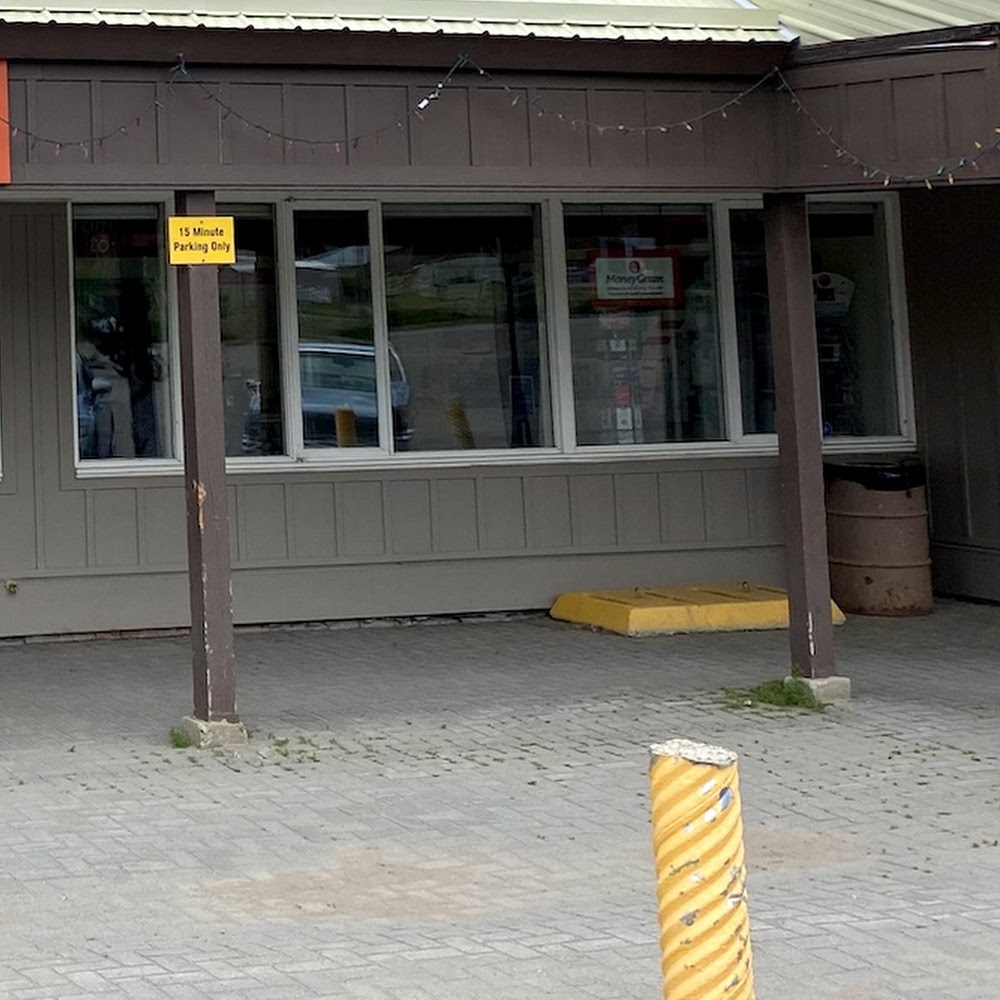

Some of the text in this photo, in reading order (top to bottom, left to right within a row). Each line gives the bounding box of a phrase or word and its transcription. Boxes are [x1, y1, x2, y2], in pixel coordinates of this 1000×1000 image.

[179, 227, 224, 237] 15 Minute
[173, 241, 231, 254] Parking Only
